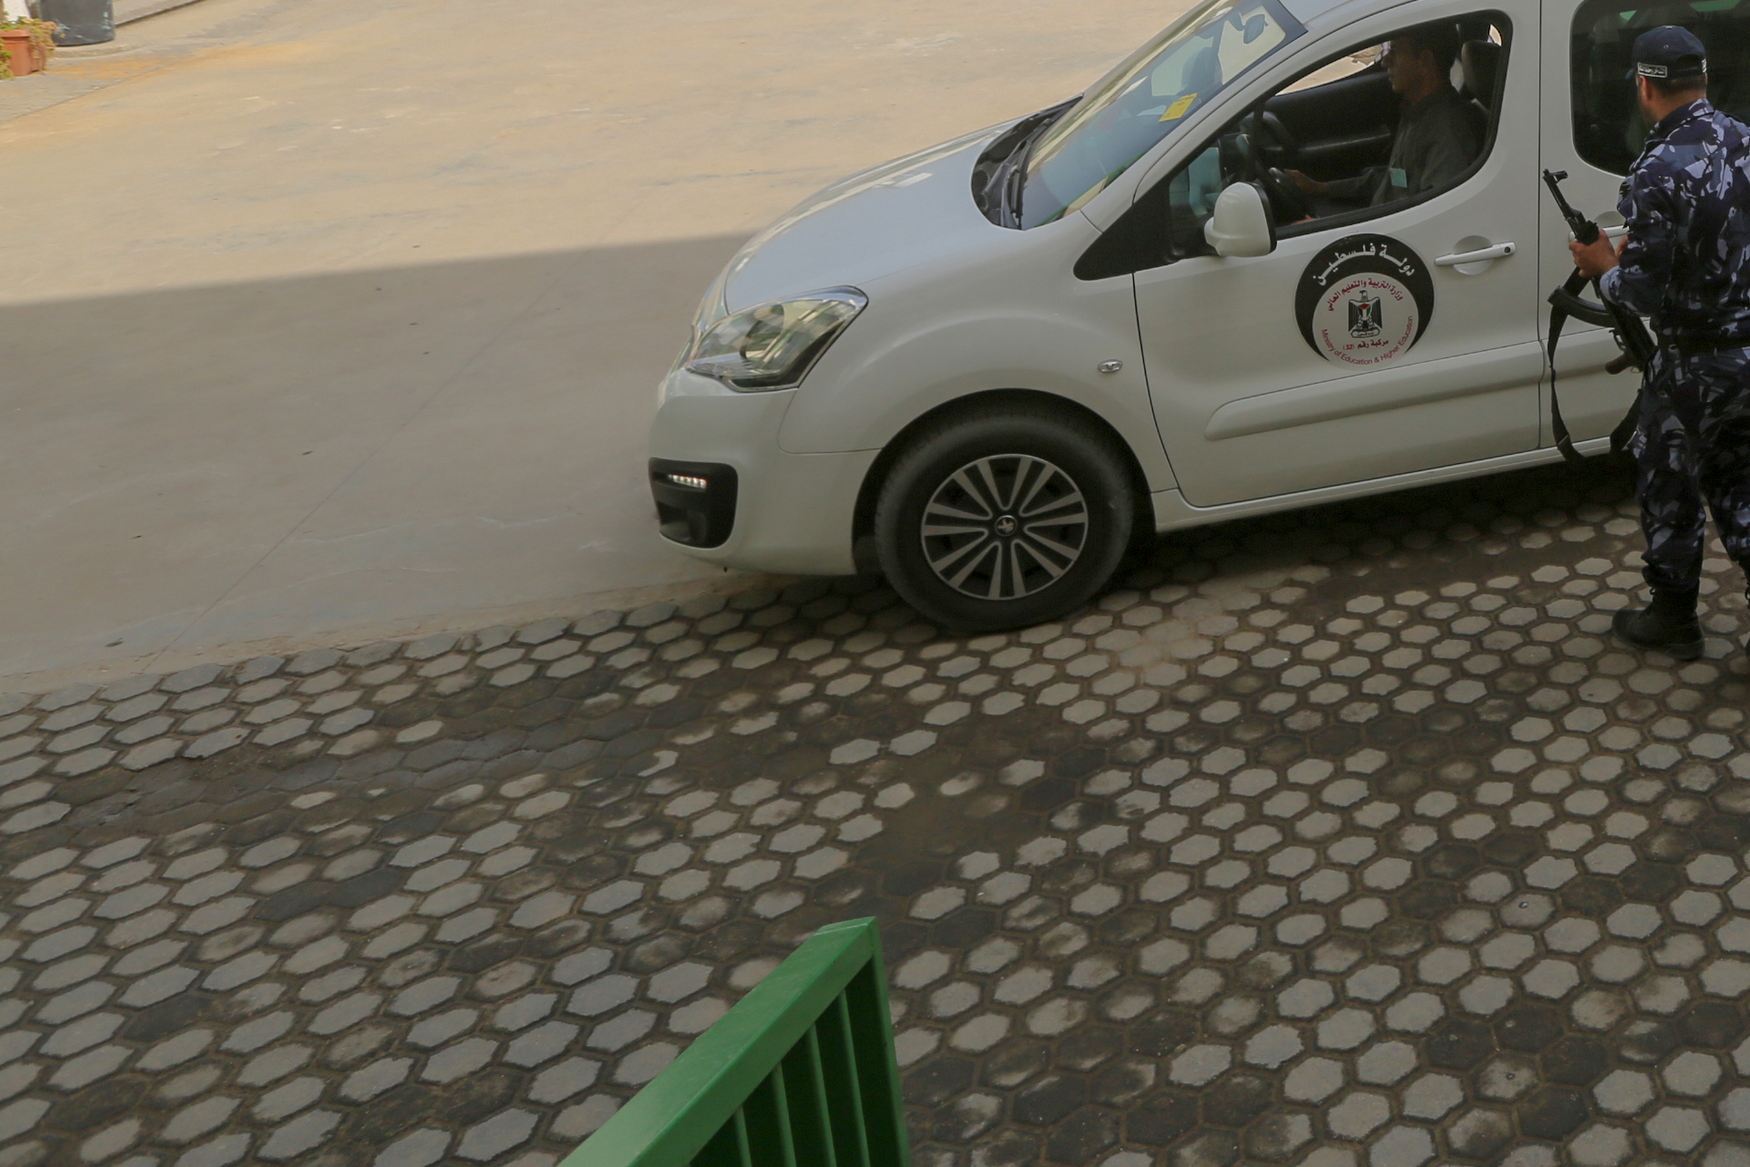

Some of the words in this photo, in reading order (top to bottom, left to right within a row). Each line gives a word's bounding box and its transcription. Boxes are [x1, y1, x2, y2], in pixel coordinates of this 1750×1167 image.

[1312, 242, 1376, 286] فلسطين
[1379, 243, 1415, 276] دولة
[1341, 279, 1367, 295] والتعليم
[1367, 277, 1391, 290] التربية
[1389, 285, 1404, 302] وزارة
[1326, 291, 1342, 312] العالي
[1321, 328, 1336, 352] Ministry
[1340, 353, 1373, 365] Education
[1373, 356, 1380, 364] &
[1380, 345, 1400, 361] Higher
[1397, 315, 1413, 346] Education
